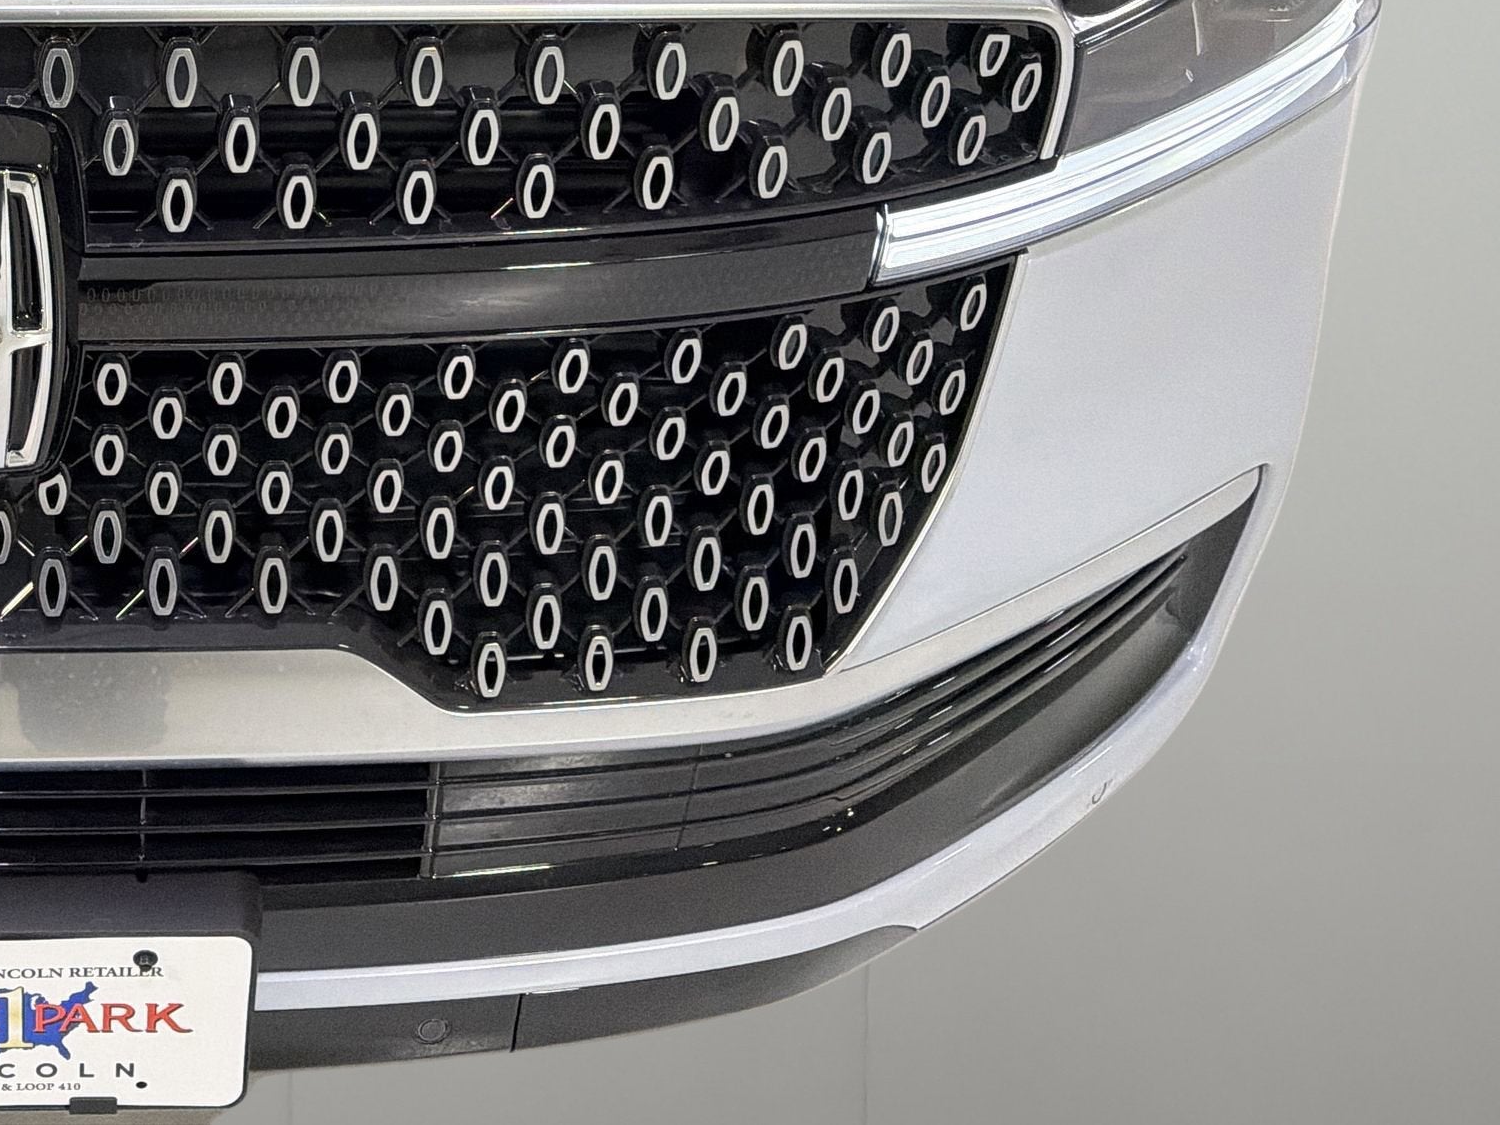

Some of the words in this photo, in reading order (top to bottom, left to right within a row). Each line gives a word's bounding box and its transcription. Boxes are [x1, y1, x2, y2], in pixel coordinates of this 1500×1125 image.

[33, 1002, 192, 1034] PARK
[1, 1083, 13, 1092] &
[16, 1083, 55, 1092] LOOP
[58, 1082, 81, 1091] 410
